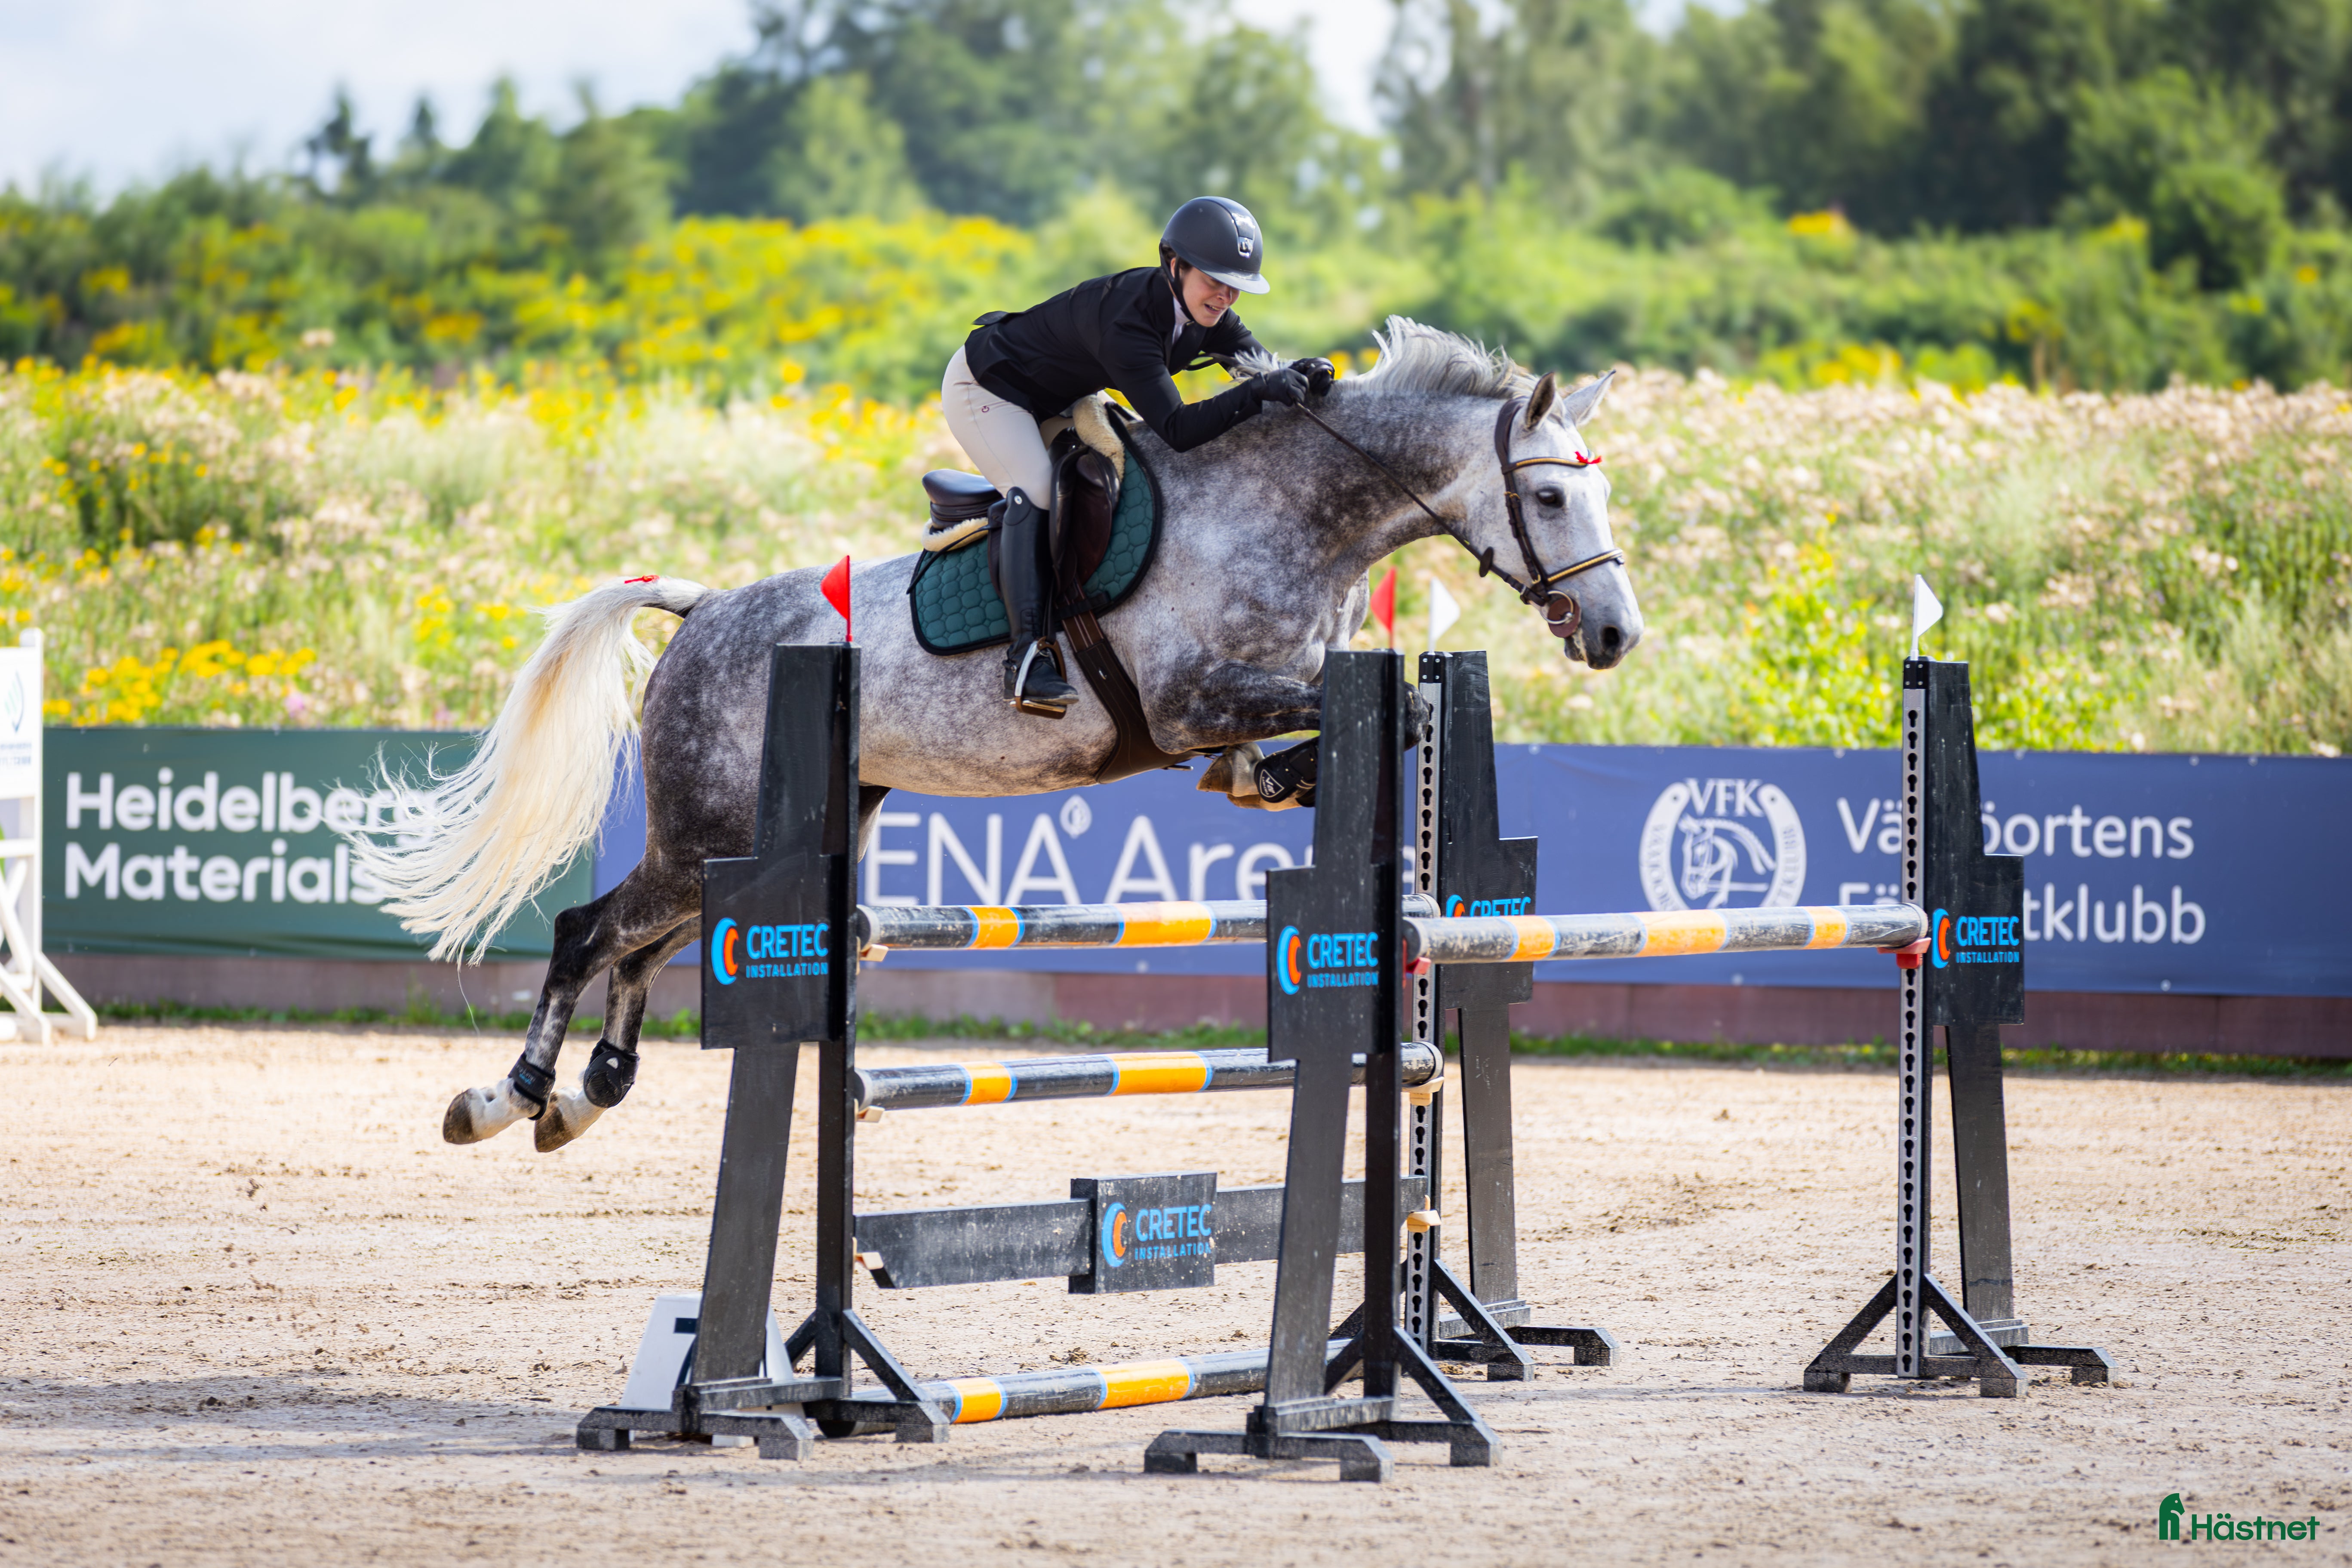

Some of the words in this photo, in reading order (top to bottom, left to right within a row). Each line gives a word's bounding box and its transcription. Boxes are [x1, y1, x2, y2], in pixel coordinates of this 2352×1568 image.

[67, 767, 437, 845] Heidelberg
[1685, 778, 1763, 817] VFK
[65, 838, 387, 905] Materials
[747, 923, 828, 959] CRETEC
[1956, 916, 2019, 946] CRETEC
[1307, 932, 1378, 969] CRETEC
[1956, 951, 2019, 963] INSTALLATION
[746, 962, 828, 978] INSTALLATION
[1307, 972, 1378, 988] INSTALLATION
[1135, 1204, 1212, 1242] CRETEC
[1134, 1242, 1212, 1260] INSTALLATION
